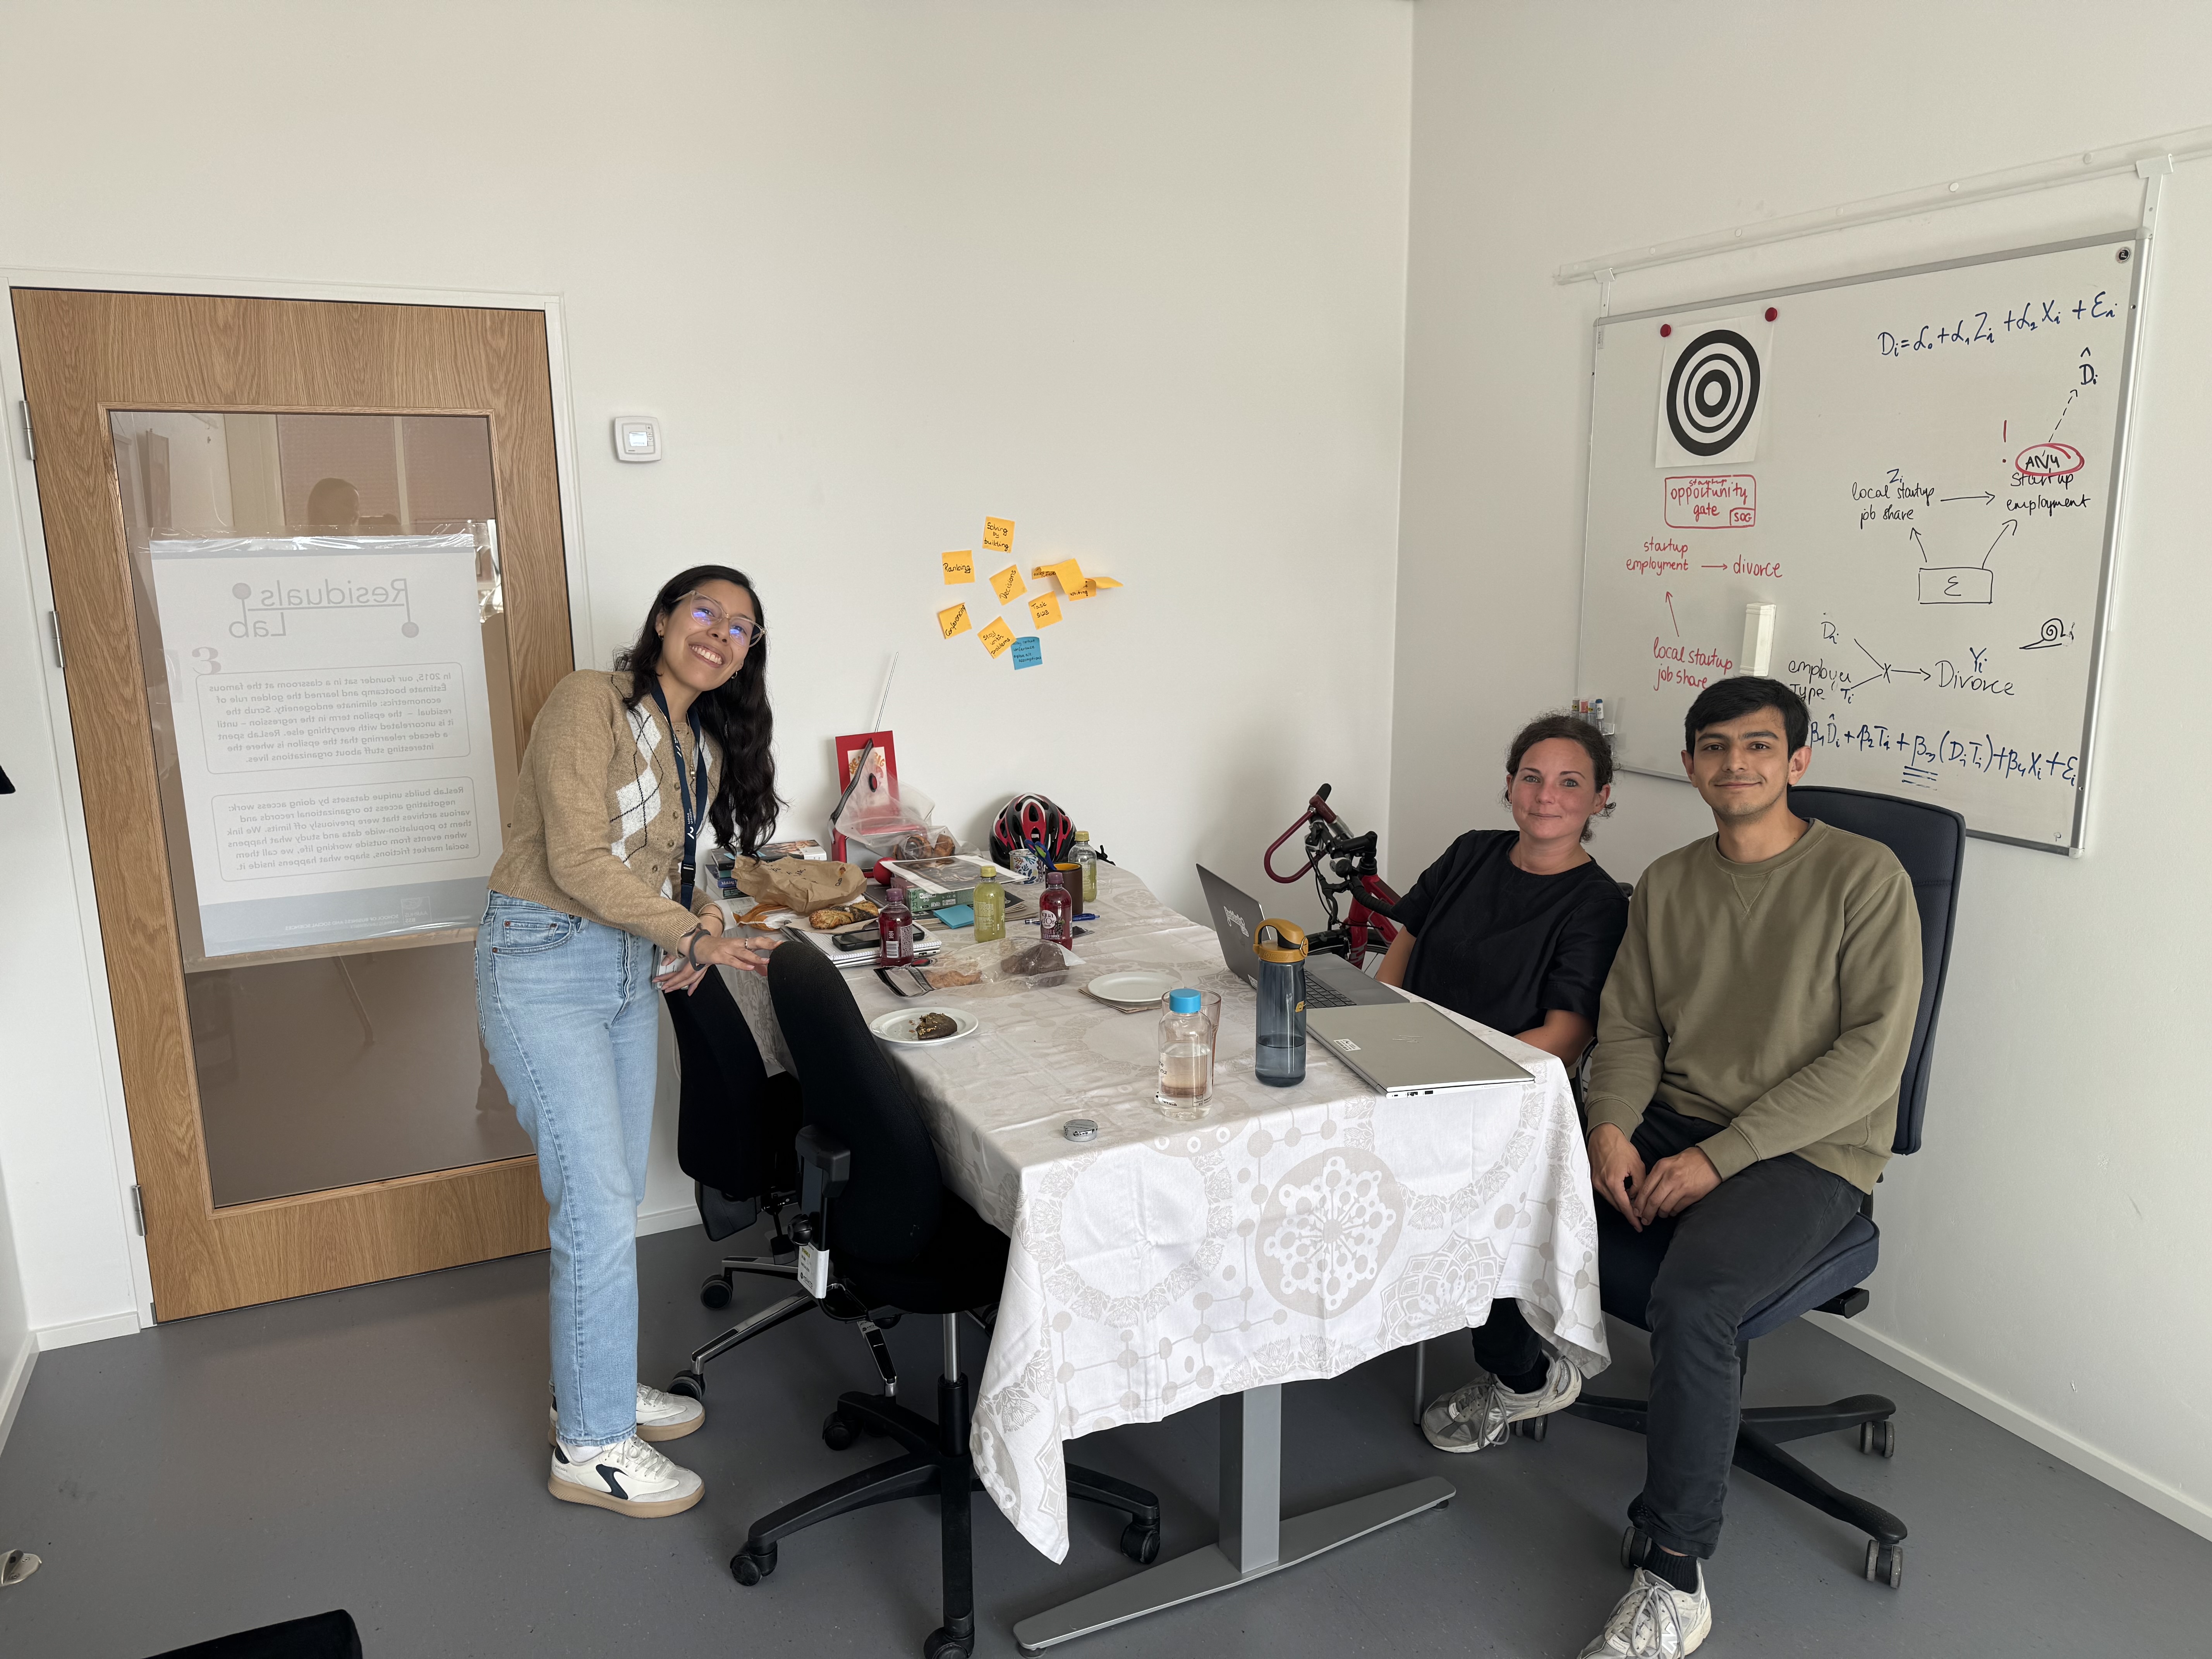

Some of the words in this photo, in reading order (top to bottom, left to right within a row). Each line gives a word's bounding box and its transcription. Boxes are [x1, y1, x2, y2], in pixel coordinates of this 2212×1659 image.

[1670, 481, 1748, 505] opportunity
[1852, 481, 1891, 501] local
[1897, 482, 1935, 506] startup
[1693, 502, 1720, 522] gate
[2006, 494, 2091, 517] employment
[1734, 512, 1752, 523] SOG
[1860, 505, 1876, 530] job
[1882, 504, 1914, 521] share
[987, 522, 1008, 536] Solving
[984, 538, 1010, 552] building
[1644, 537, 1688, 558] startup
[943, 562, 972, 574] Ranking
[1626, 556, 1688, 575] employment
[1733, 554, 1783, 578] divorce
[999, 569, 1016, 599] Decisions
[1031, 601, 1047, 610] Task
[1036, 610, 1049, 618] size
[945, 604, 967, 637] Conferencing
[982, 630, 996, 641] Stay
[989, 634, 1004, 646] with
[1653, 637, 1685, 662] local
[1688, 648, 1733, 675] startup
[1653, 663, 1673, 691] job
[1676, 669, 1708, 690] share
[1935, 660, 2015, 696] Divorce
